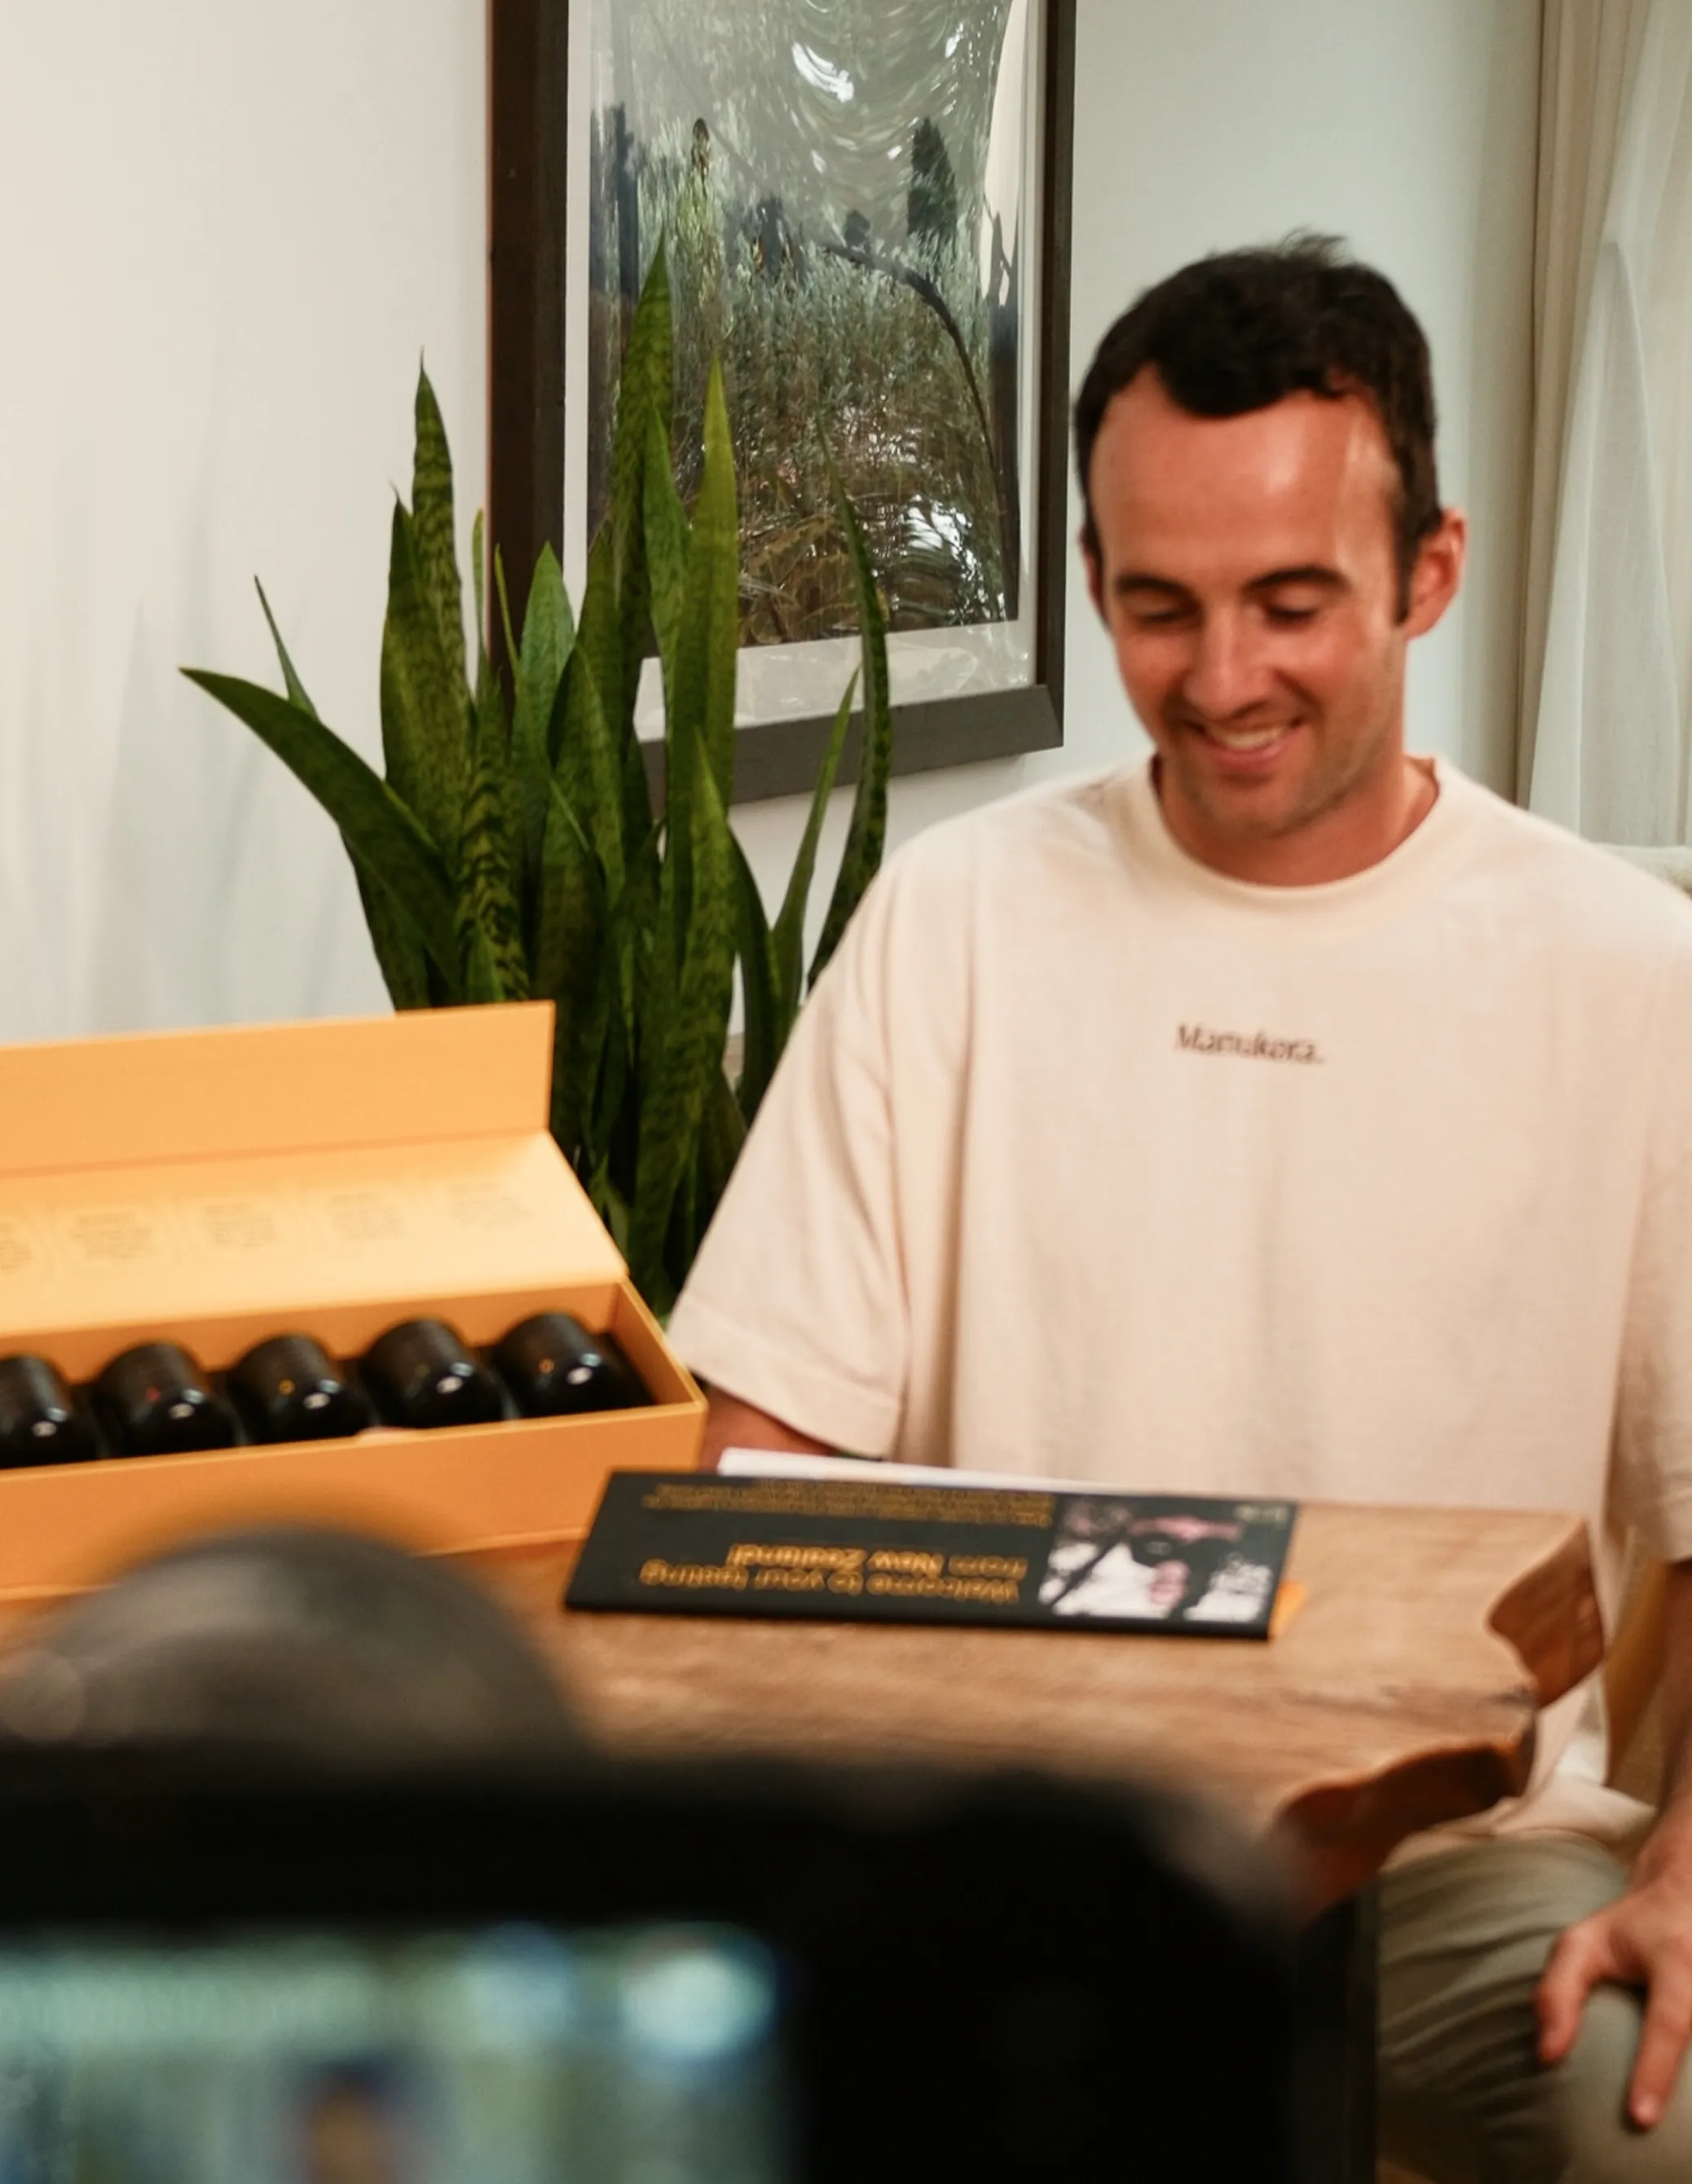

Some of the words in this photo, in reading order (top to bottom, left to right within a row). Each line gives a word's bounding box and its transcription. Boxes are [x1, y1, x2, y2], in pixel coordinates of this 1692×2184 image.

[866, 1550, 944, 1579] New
[949, 1554, 1028, 1581] from
[827, 1570, 863, 1596] to
[866, 1572, 1019, 1605] Welcome
